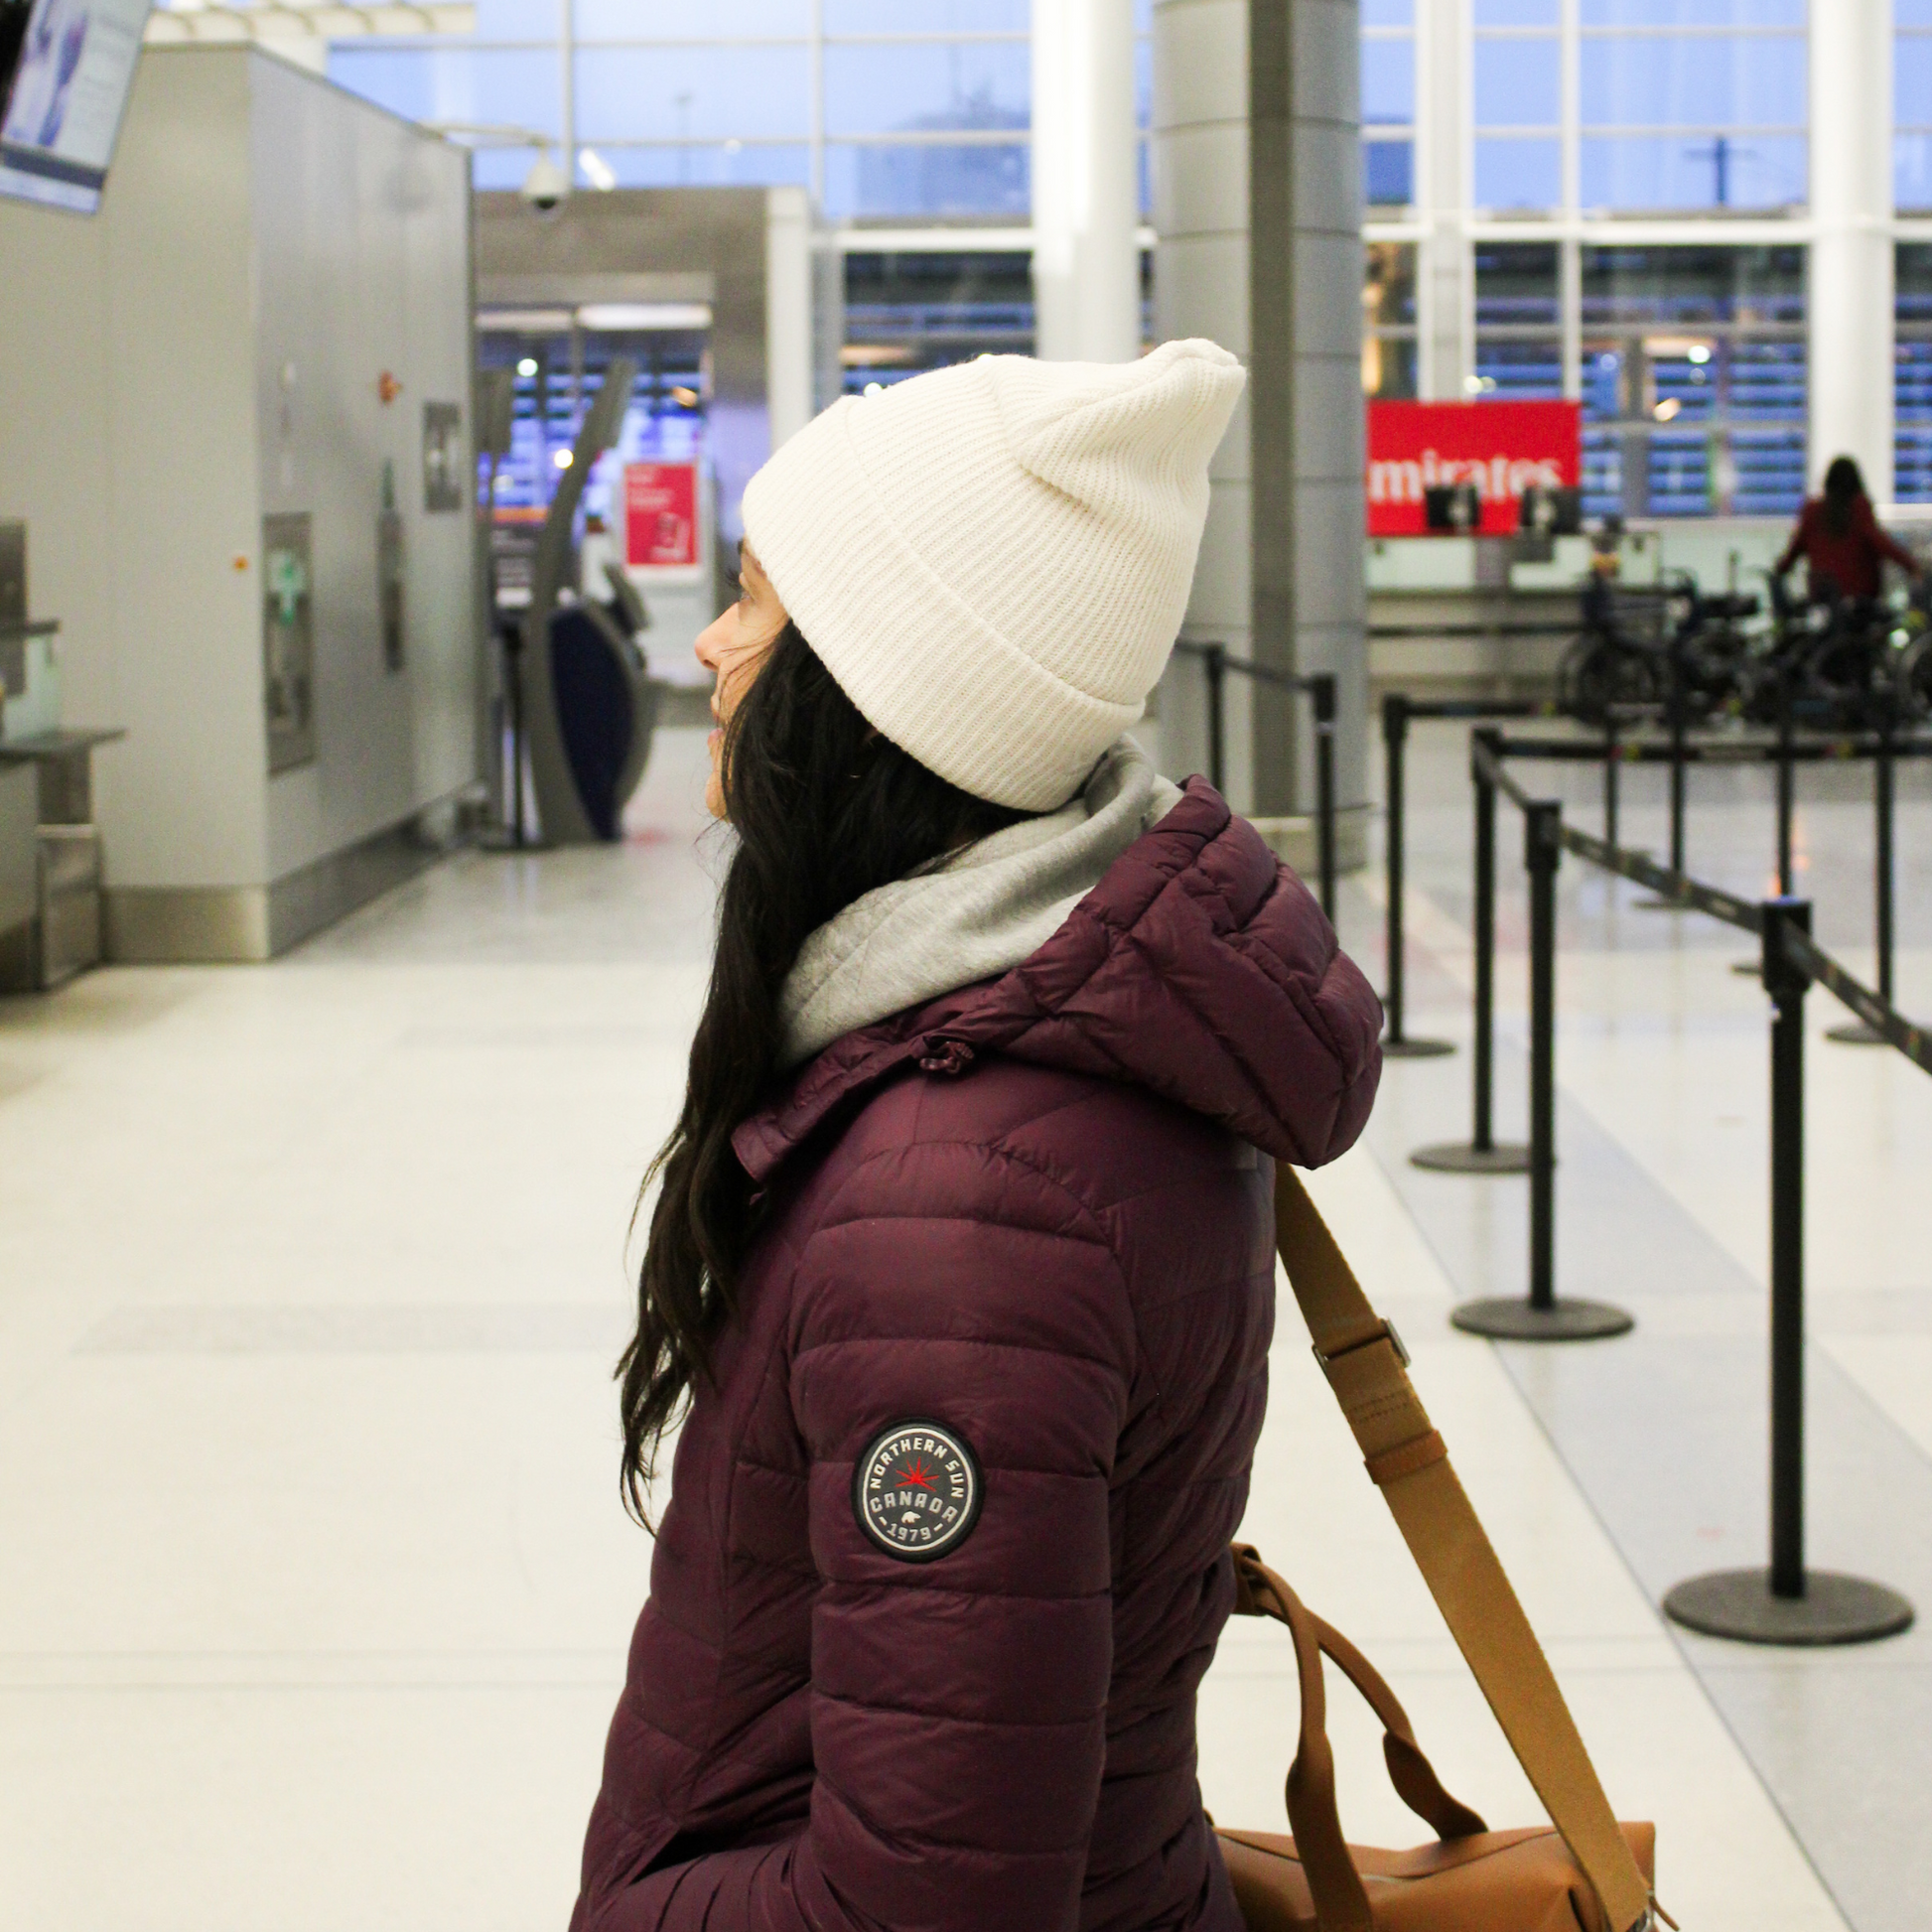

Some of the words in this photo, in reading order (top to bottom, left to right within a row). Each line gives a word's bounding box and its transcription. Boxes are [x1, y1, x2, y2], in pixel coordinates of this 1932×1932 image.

[1367, 449, 1564, 502] mirates
[870, 1437, 947, 1489] NORTHERN
[945, 1459, 965, 1498] SUN
[870, 1491, 958, 1523] CANADA
